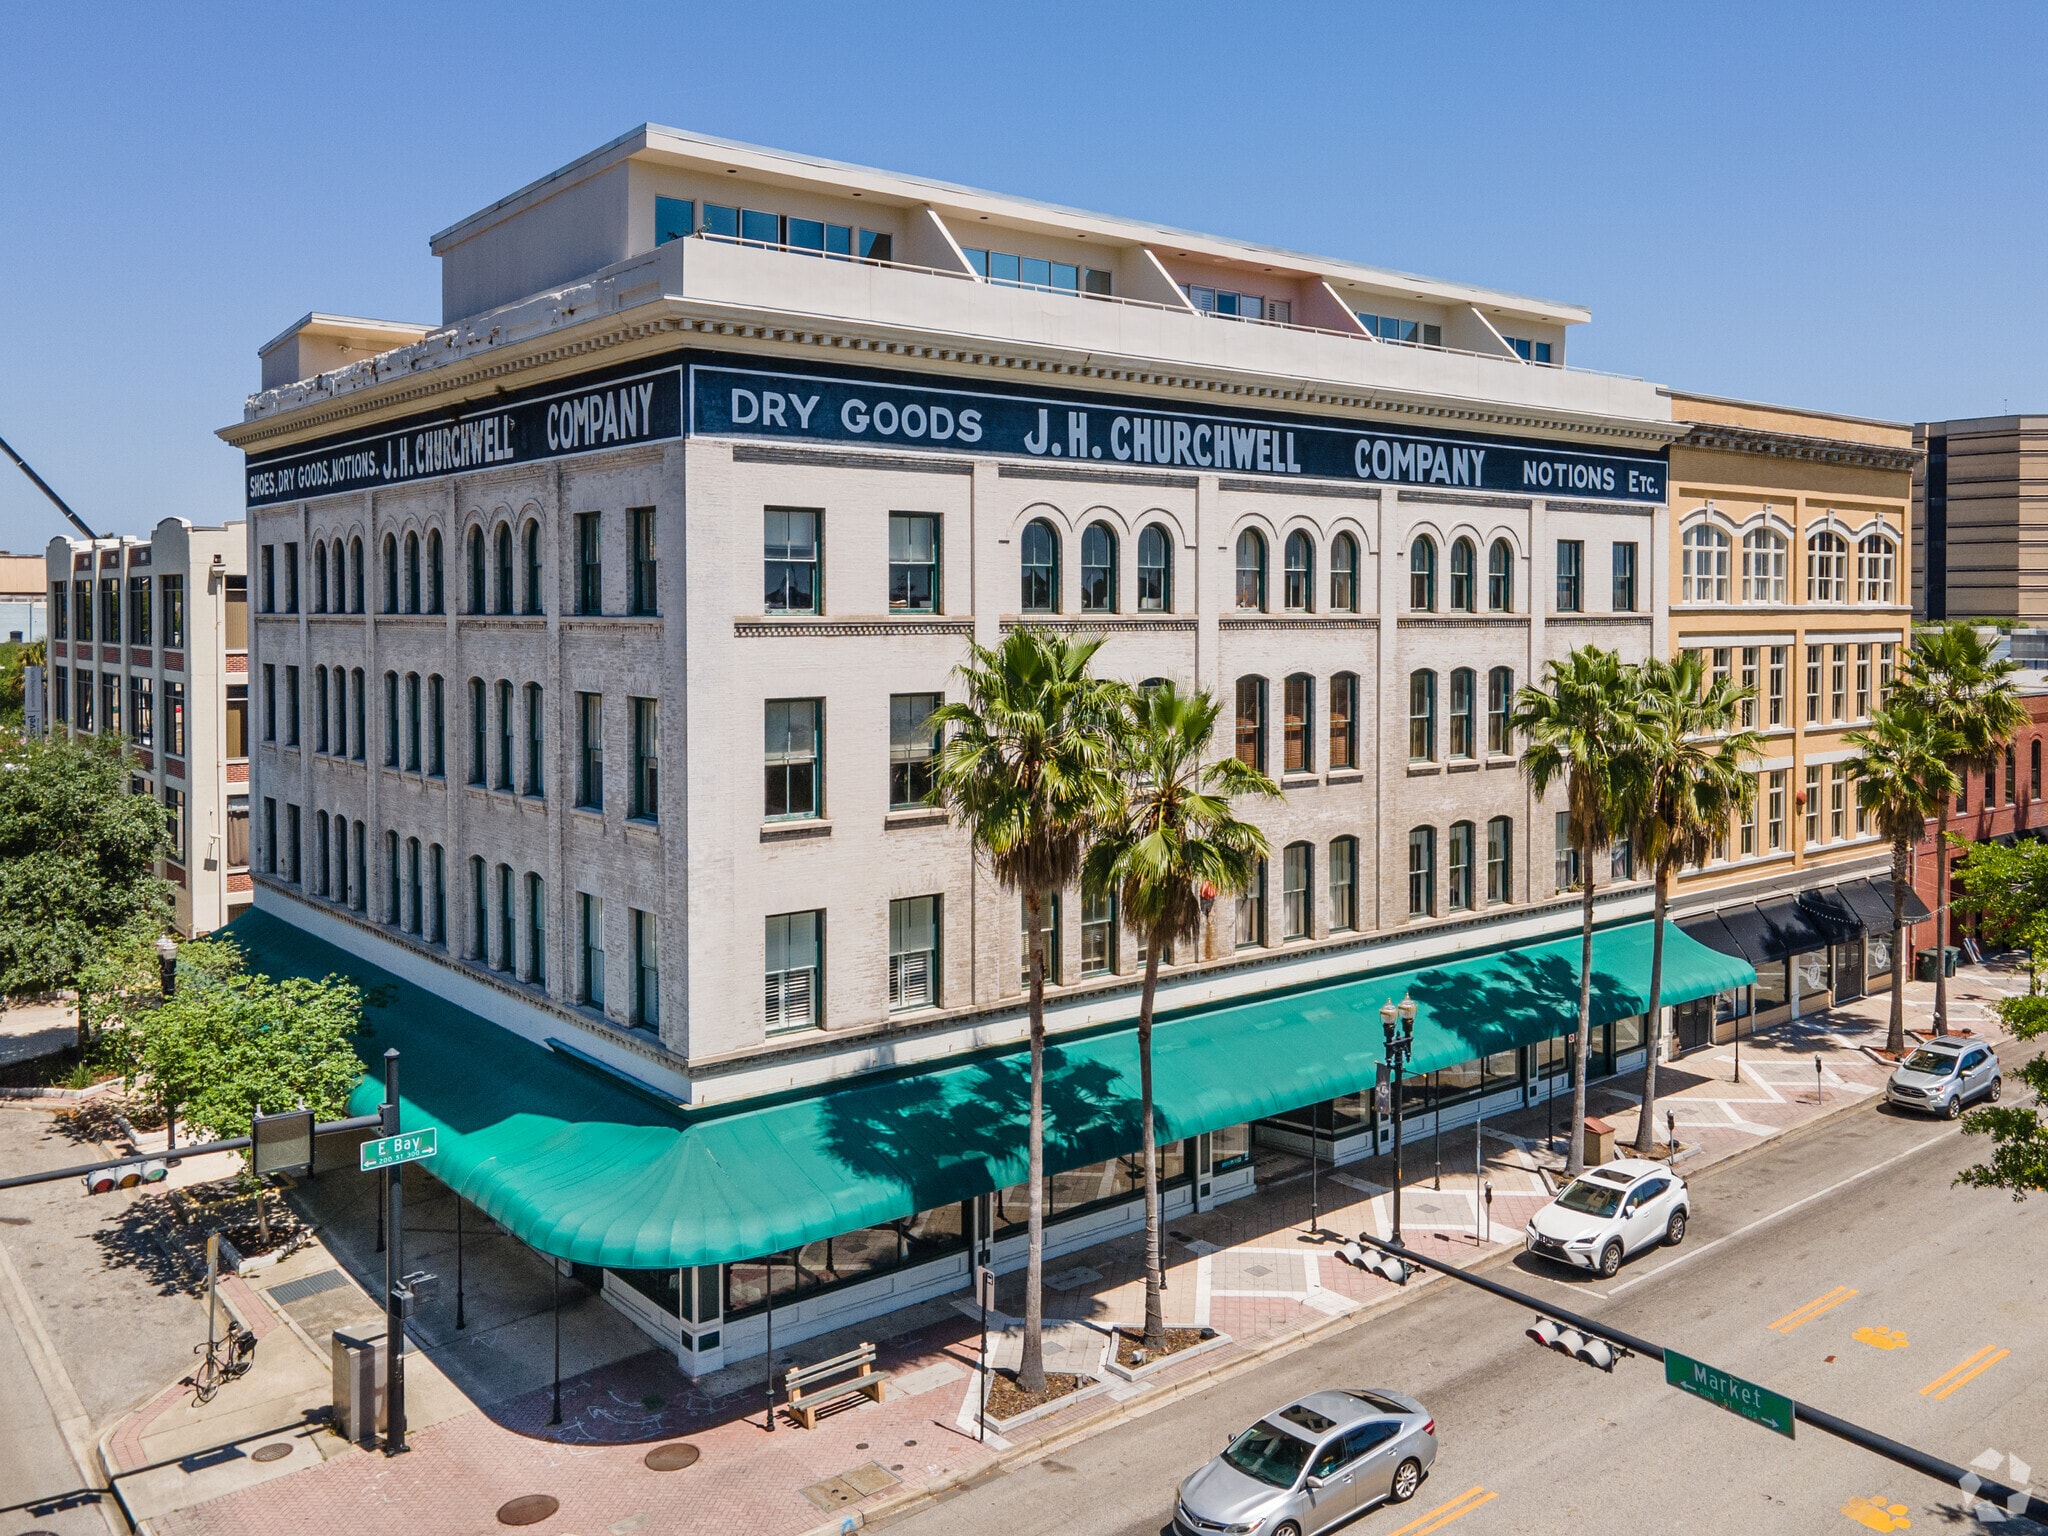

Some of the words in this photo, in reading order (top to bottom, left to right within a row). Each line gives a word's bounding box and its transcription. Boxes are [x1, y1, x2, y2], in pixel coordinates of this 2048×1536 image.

[278, 468, 295, 493] DRY
[332, 450, 379, 482] NOTIONS.
[415, 414, 514, 474] CHURCHWELL
[547, 382, 654, 451] COMPANY
[731, 388, 820, 429] DRY
[841, 398, 983, 443] GOODS
[1110, 416, 1302, 474] CHURCHWELL
[1354, 439, 1486, 487] COMPANY
[1523, 460, 1616, 491] NOTIONS
[378, 1141, 386, 1156] E
[394, 1137, 420, 1153] Bay
[379, 1156, 393, 1165] 200
[406, 1150, 420, 1159] 300
[1694, 1363, 1761, 1409] Market
